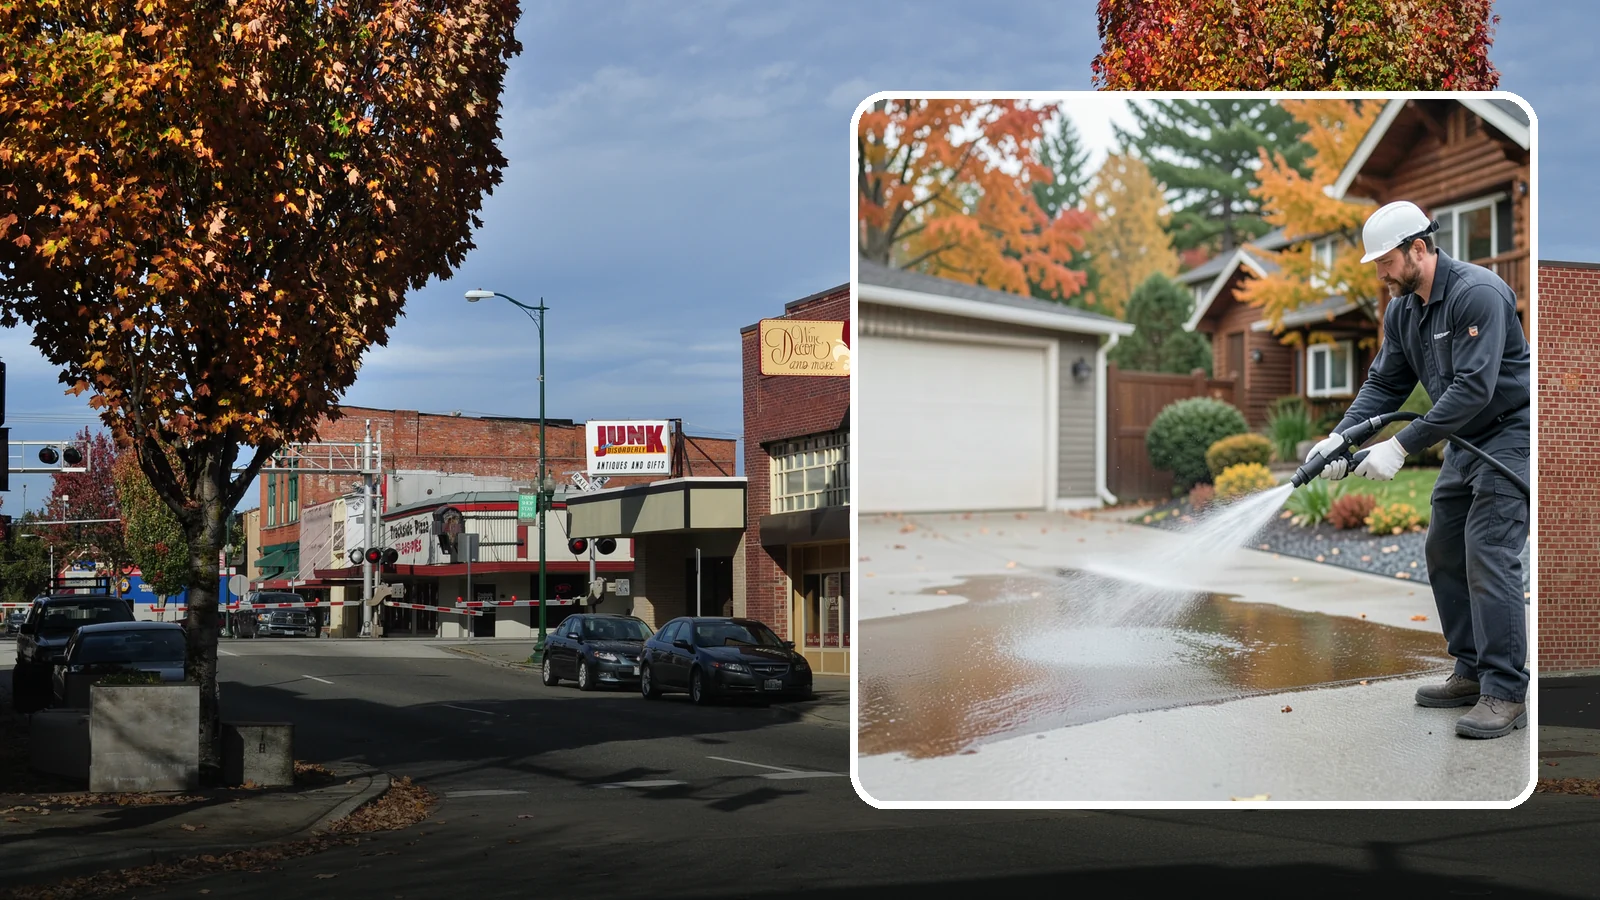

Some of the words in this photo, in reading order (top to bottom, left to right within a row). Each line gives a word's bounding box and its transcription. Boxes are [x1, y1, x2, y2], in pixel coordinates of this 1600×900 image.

[595, 425, 666, 457] JUNK
[607, 446, 645, 454] DISORDERLY
[597, 461, 628, 470] ANTIQUES
[631, 461, 643, 470] AND
[647, 460, 665, 470] GIFTS
[414, 519, 429, 534] Pizza
